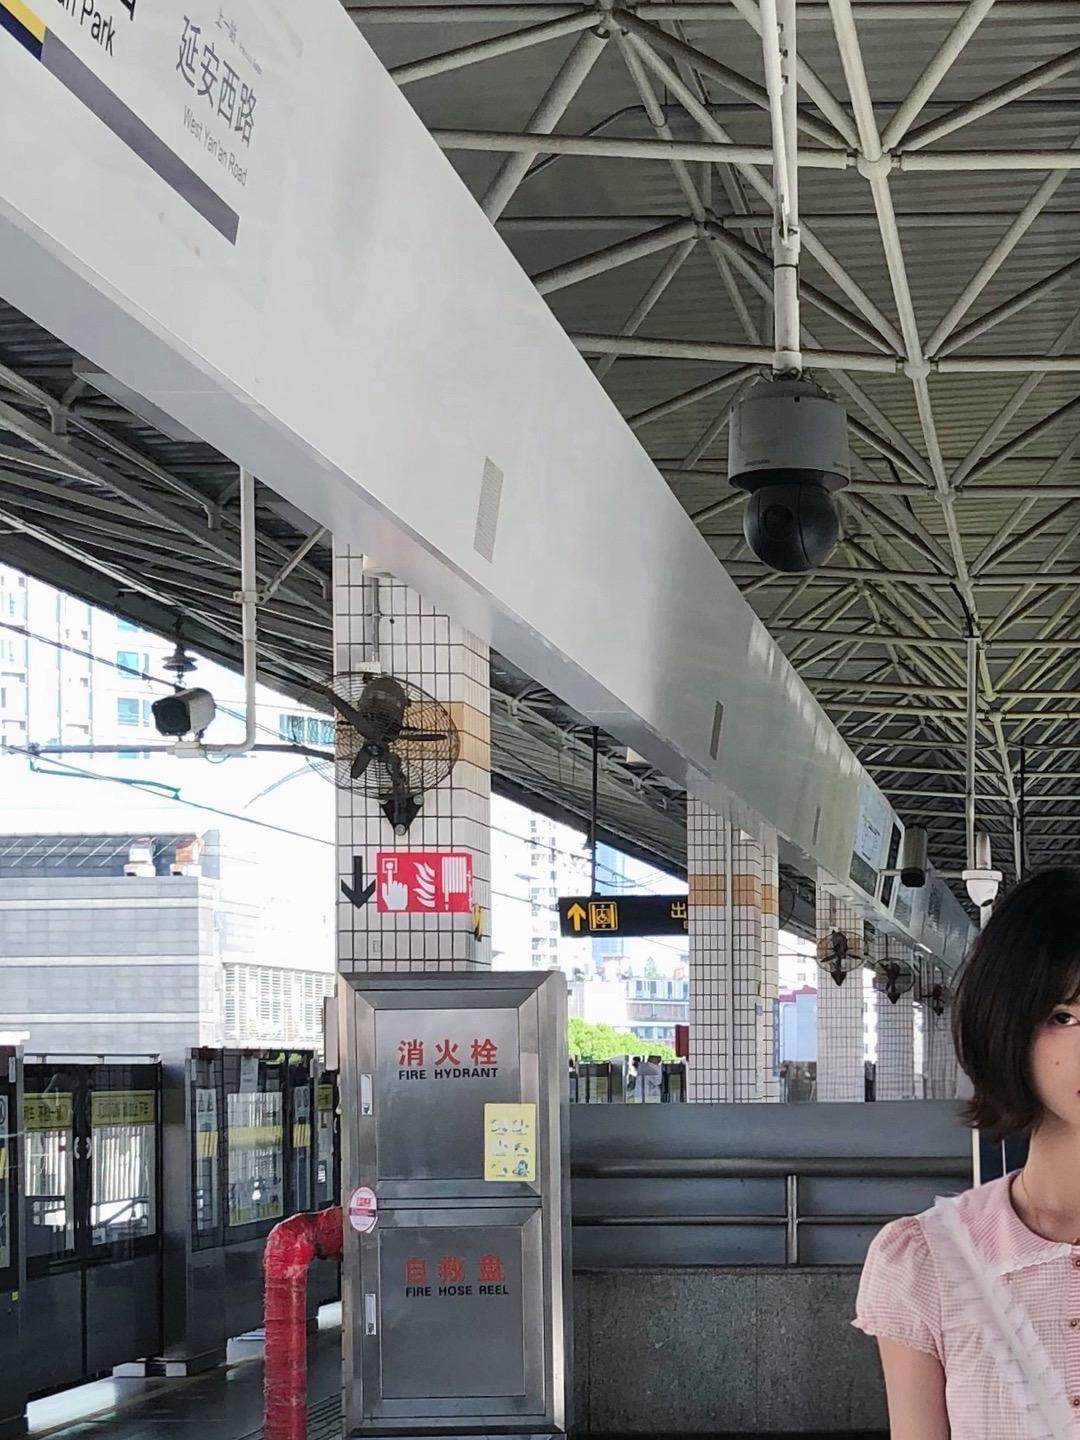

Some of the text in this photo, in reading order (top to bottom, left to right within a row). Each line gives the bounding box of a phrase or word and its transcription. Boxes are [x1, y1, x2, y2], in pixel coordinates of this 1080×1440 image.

[79, 0, 116, 56] Park
[176, 15, 256, 148] 延安西路
[183, 105, 248, 187] West Yan'an Road
[398, 1038, 498, 1066] 消火栓
[399, 1067, 498, 1080] FIRE HYDRANT
[406, 1284, 509, 1297] FIRE HOSE REEL
